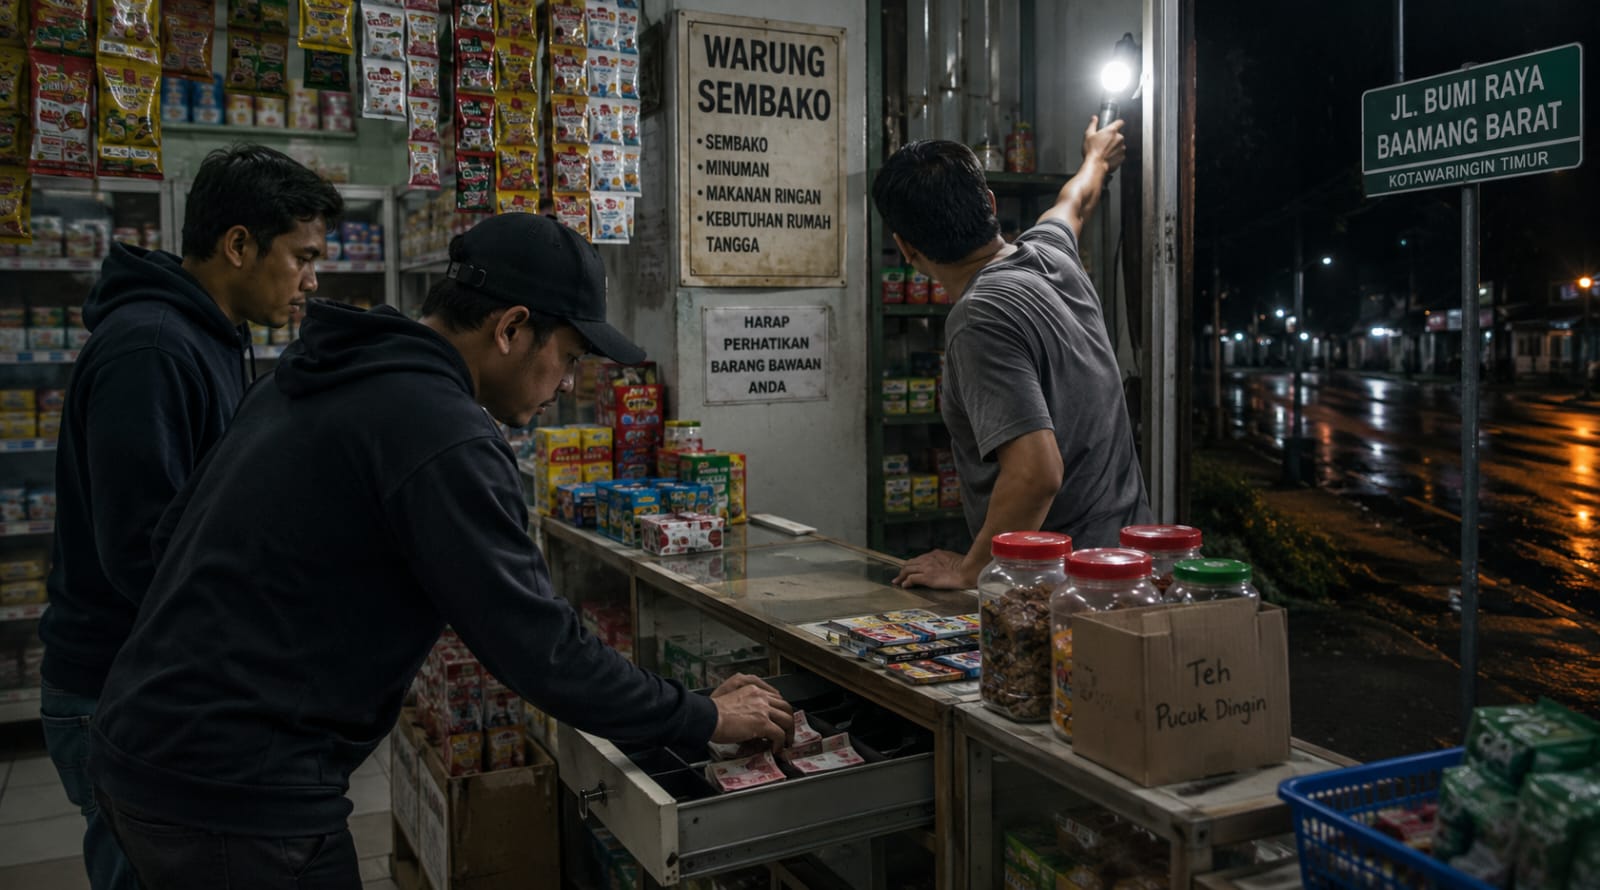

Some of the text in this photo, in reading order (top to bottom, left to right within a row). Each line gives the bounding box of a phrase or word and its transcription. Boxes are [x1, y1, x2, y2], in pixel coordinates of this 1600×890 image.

[703, 34, 825, 78] WARUNG
[697, 79, 831, 122] SEMBAKO
[1390, 64, 1545, 121] JL. BUMI RAYA
[1377, 100, 1563, 160] BAAMANG BARAT
[705, 134, 768, 153] SEMBAKO
[705, 159, 770, 178] MINUMAN
[1388, 151, 1549, 188] KOTAWARINGIN TIMUR
[705, 185, 821, 205] MAKANAN RINGAN
[705, 211, 831, 230] KEBUTUHAN RUMAH
[705, 236, 760, 253] TANGGA
[744, 316, 790, 329] HARAP
[724, 336, 809, 351] PERHATIKAN
[711, 358, 822, 374] BARANG BAWAAN
[748, 381, 787, 394] ANDA
[1186, 657, 1231, 688] Teh
[1155, 696, 1267, 731] Pucuk Dingin
